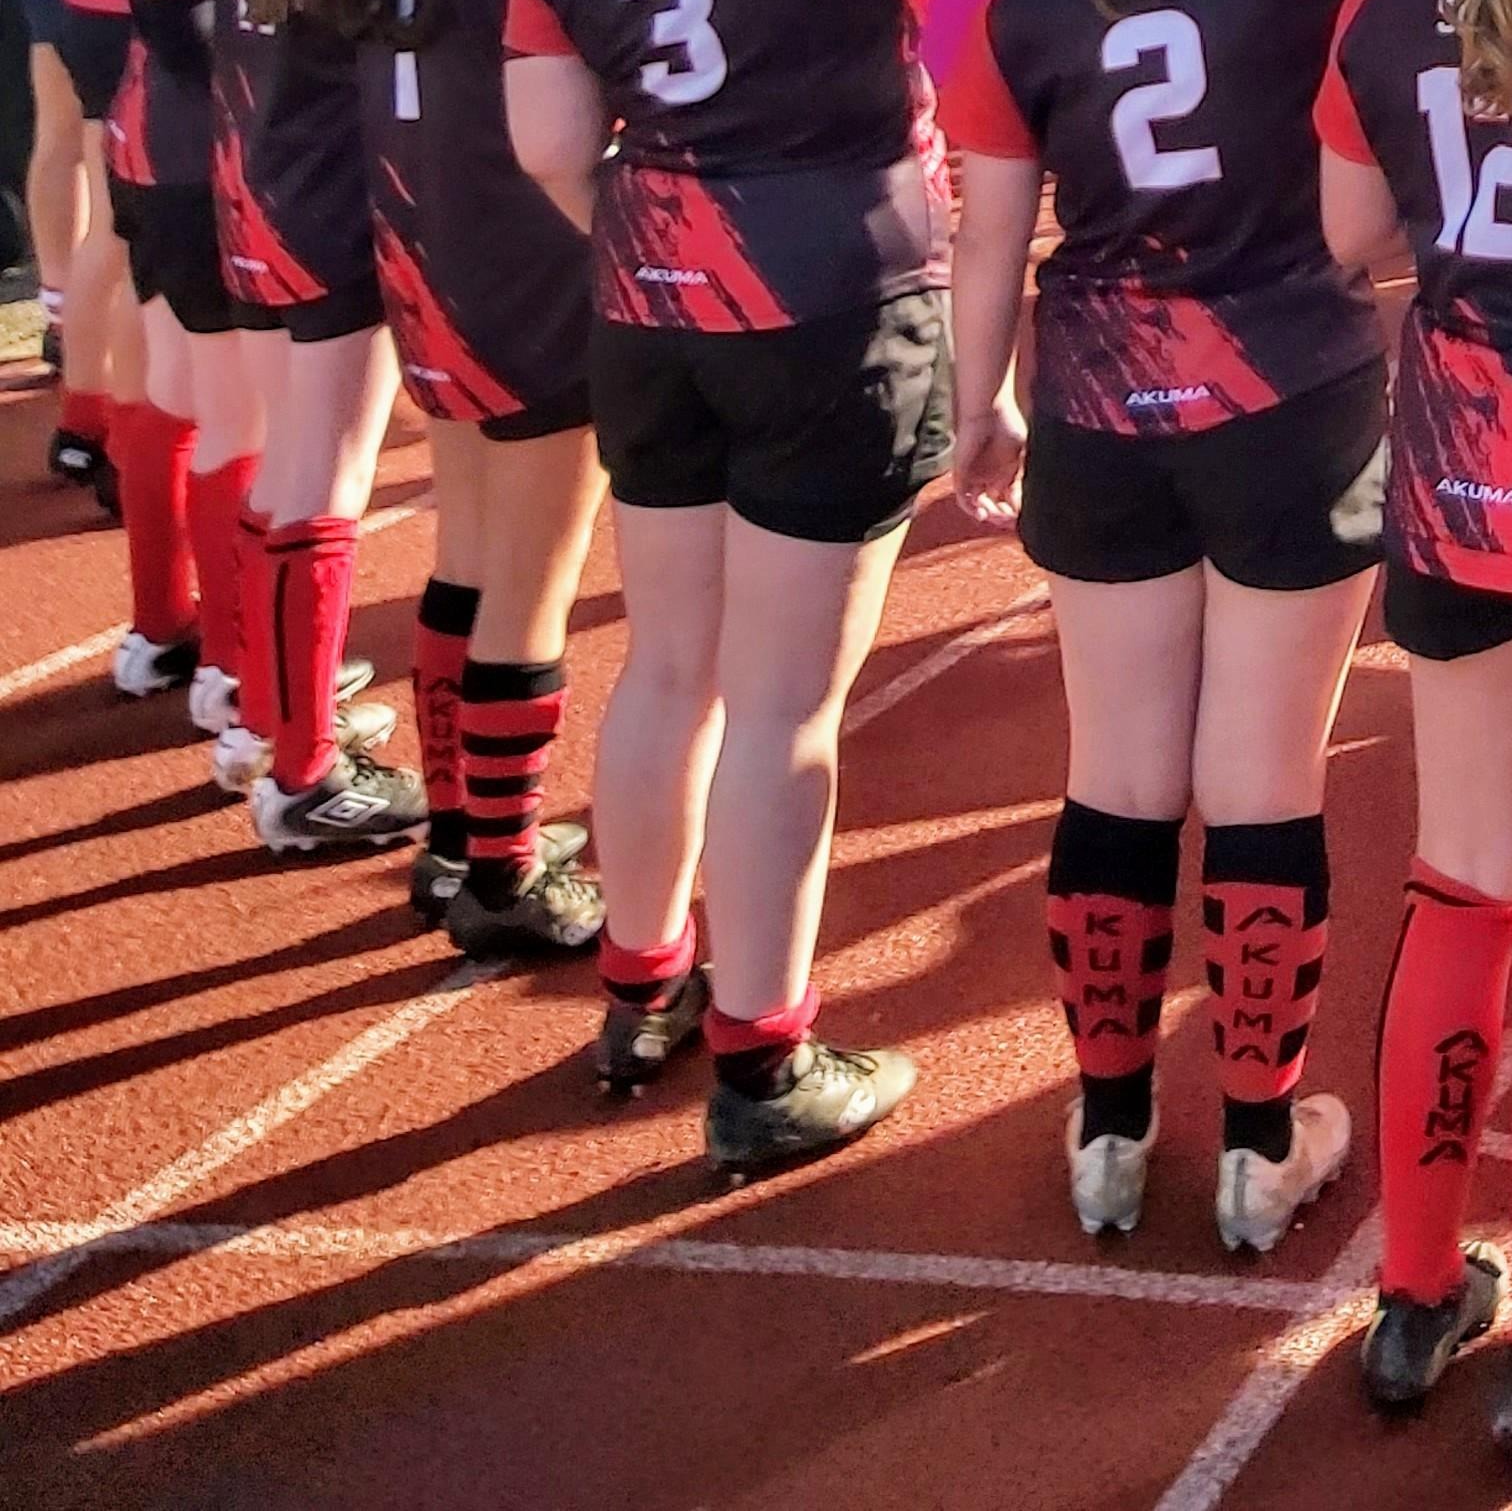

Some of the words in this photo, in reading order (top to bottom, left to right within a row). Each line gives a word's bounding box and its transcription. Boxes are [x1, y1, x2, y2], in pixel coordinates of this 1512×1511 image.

[1102, 8, 1224, 190] 2
[1125, 384, 1211, 406] AKUMA
[1230, 905, 1293, 1067] AKUMA
[1418, 1029, 1490, 1167] AKUMA
